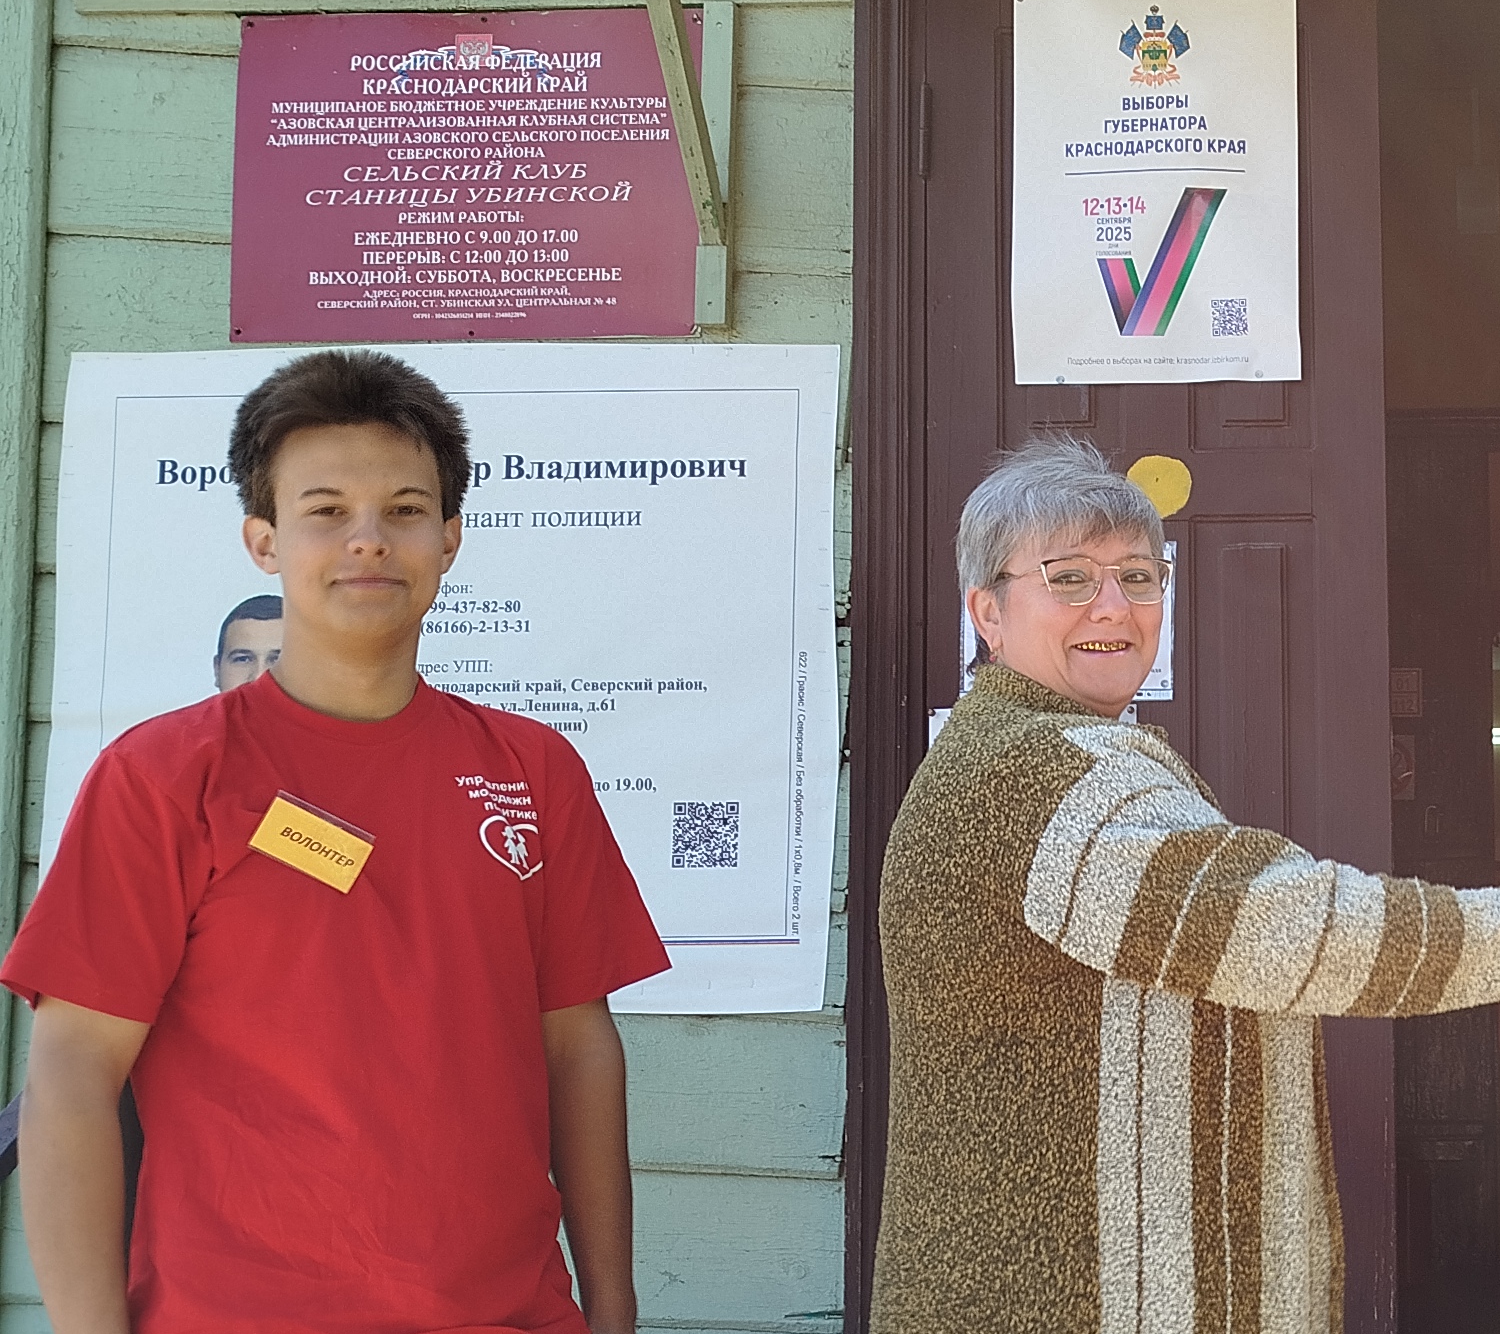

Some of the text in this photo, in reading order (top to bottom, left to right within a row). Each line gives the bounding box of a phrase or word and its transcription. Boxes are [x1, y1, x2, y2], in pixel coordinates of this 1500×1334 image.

[350, 51, 602, 73] РОССИЙСКАЯ ФЕДЕРАЦИЯ
[362, 71, 588, 97] КРАСНОДАРСКИЙ КРАЙ
[271, 97, 667, 115] МУНИЦИПАНОЕ БЮДЖЕТНОЕ УЧРЕЖДЕНИЕ КУЛЬТУРЫ
[1122, 94, 1189, 112] ВЫБОРЫ
[358, 116, 516, 131] ЦЕНТРАЛИЗОВАННАЯ
[519, 115, 588, 127] КЛУБНАЯ
[1104, 116, 1208, 135] ГУБЕРНАТОРА
[266, 129, 670, 147] АДМИНИСТРАЦИИ АЗОВСКОГО СЕЛЬСКОГО ПОСЕЛЕНИЯ
[387, 144, 545, 160] СЕВЕРСКОГО РАЙОНА
[1065, 138, 1247, 158] КРАСНОДАРСКОГО КРАЯ
[343, 160, 587, 183] СЕЛЬСКИЙ КЛУБ
[305, 181, 633, 208] СТАНИЦЫ УБИНСКОЙ
[398, 210, 525, 224] РЕЖИМ РАБОТЫ:
[1096, 217, 1132, 225] СЕНТЯБРЯ
[354, 229, 579, 247] ЕЖЕДНЕВНО С 9.00 ДО 17.00
[1096, 226, 1132, 242] 2025
[362, 249, 569, 265] ПЕРЕРЫВ: С 12:00 ДО 13:00
[309, 266, 622, 286] ВЫХОДНОЙ: СУББОТА, ВОСКРЕСЕНЬЕ
[448, 286, 538, 298] КРАСНОДАРСКИЙ
[317, 298, 379, 309] СЕВЕРСКИЙ
[440, 299, 495, 308] УБИНСКАЯ
[515, 297, 591, 308] ЦЕНТРАЛЬНАЯ
[605, 297, 617, 306] 48
[1067, 357, 1105, 366] Подробнее
[156, 458, 233, 492] Воро
[502, 454, 748, 486] Владимирович
[531, 509, 642, 530] полиции
[429, 600, 521, 614] 99-437-82-80
[418, 659, 493, 676] дрес УПП:
[525, 677, 567, 695] край,
[571, 677, 653, 695] Северский
[657, 677, 708, 695] район,
[587, 698, 616, 714] д.61
[615, 777, 657, 793] 19.00,
[280, 826, 355, 868] ВОЛОНТЕР
